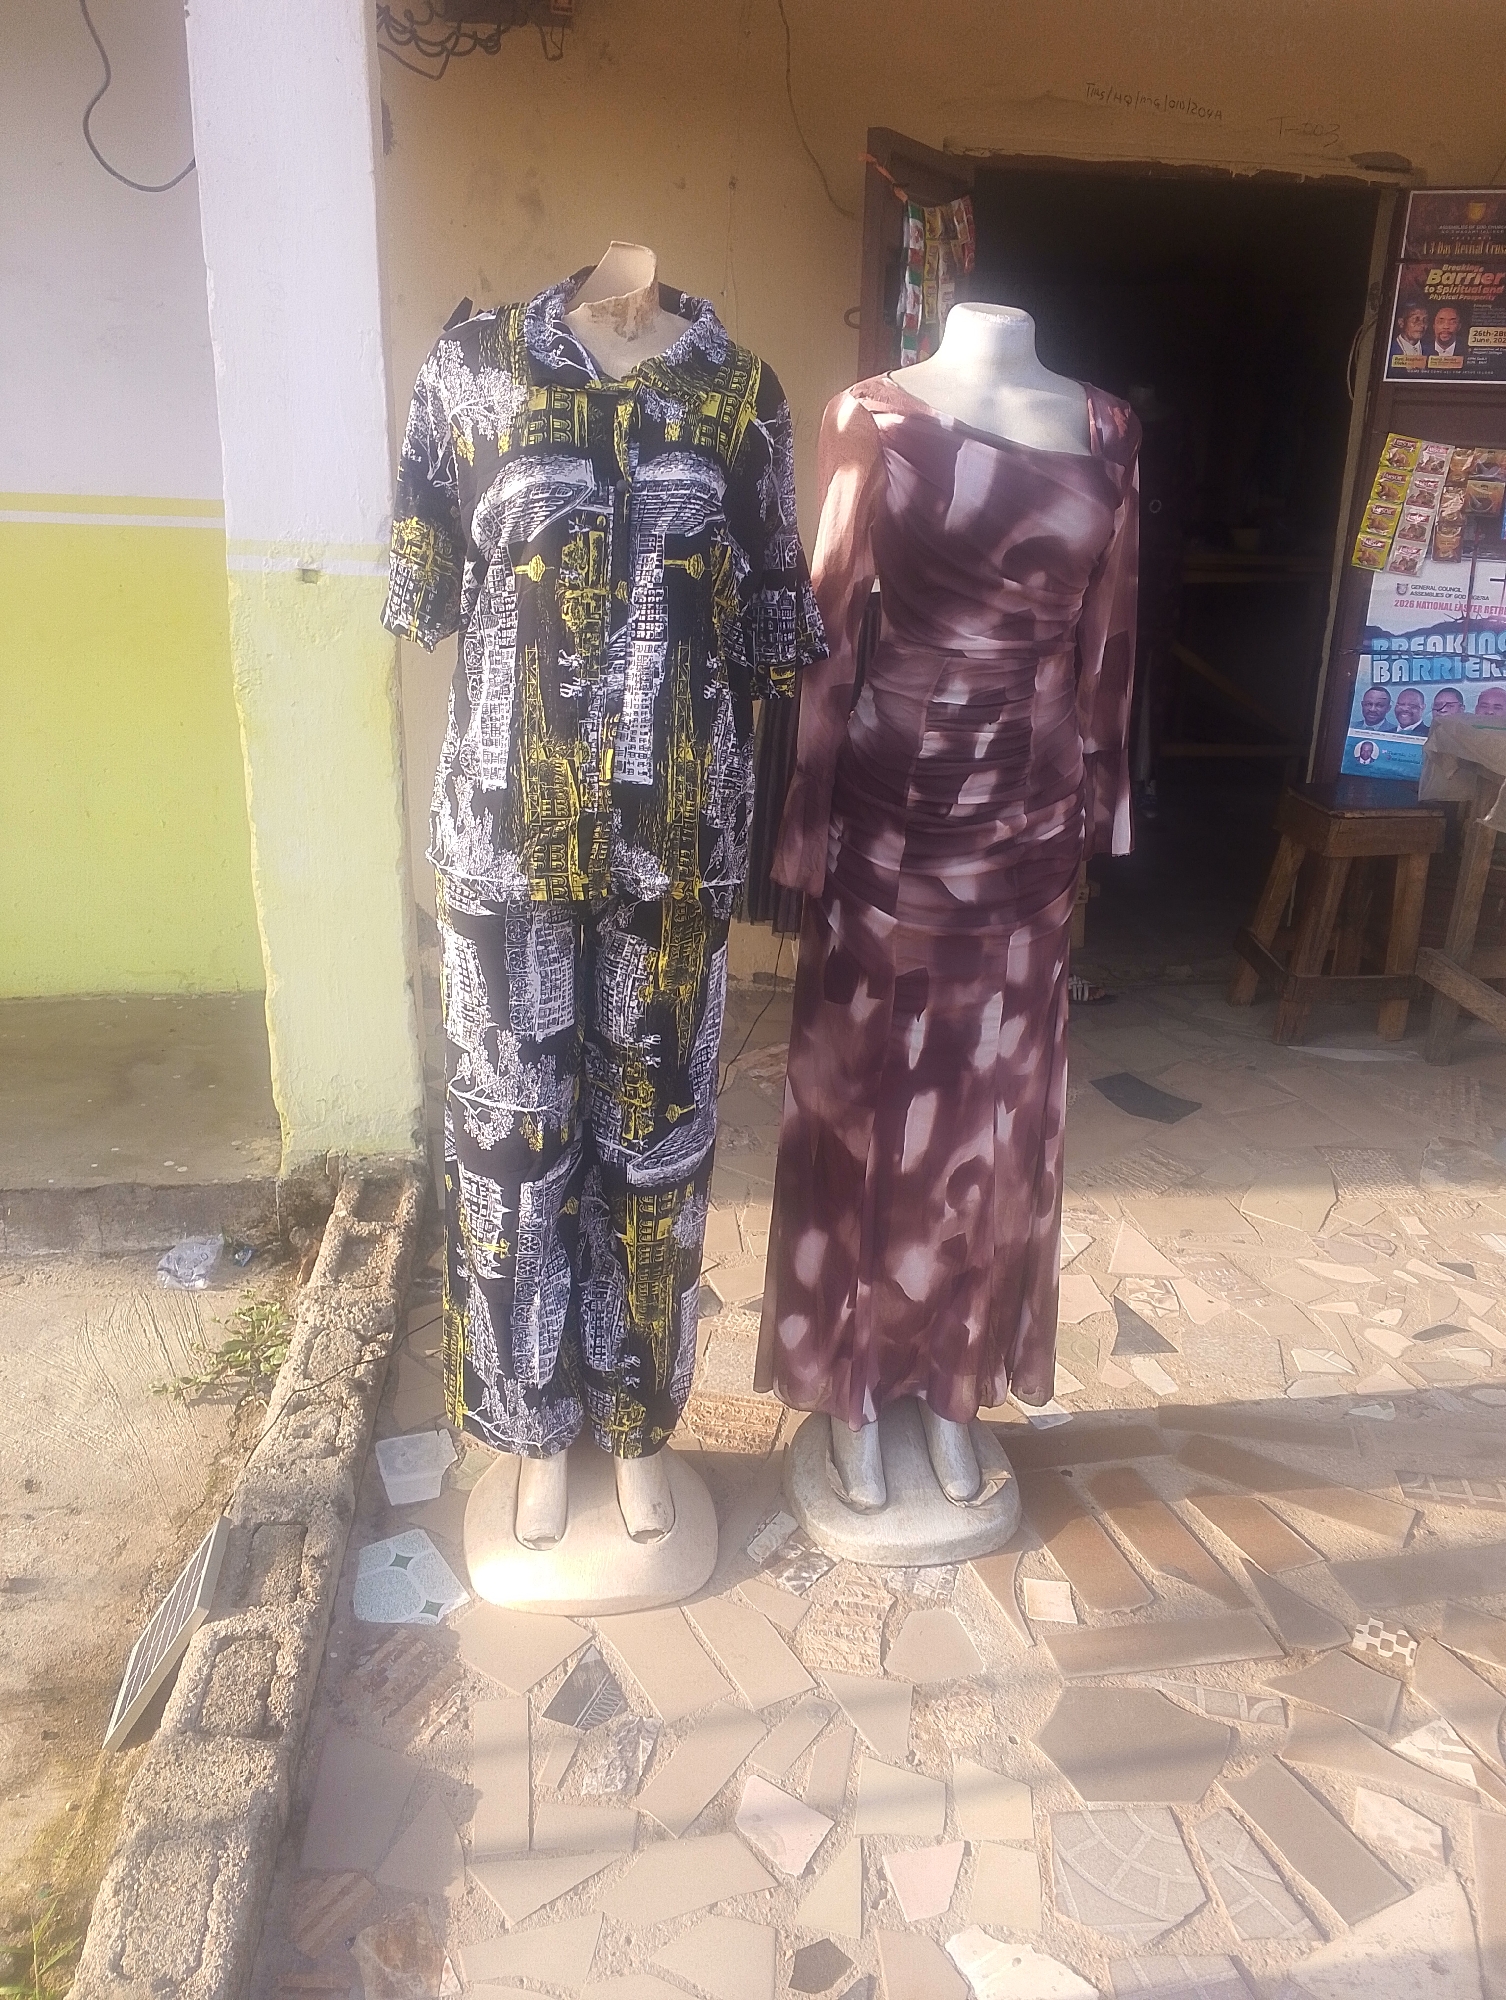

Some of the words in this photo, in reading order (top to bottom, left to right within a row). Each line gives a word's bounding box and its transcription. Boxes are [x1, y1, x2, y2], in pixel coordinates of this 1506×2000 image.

[1424, 285, 1435, 293] to
[1436, 284, 1482, 294] Spiritual
[1482, 285, 1505, 294] and
[1394, 600, 1415, 608] 2026
[1416, 600, 1453, 611] NATIONAL
